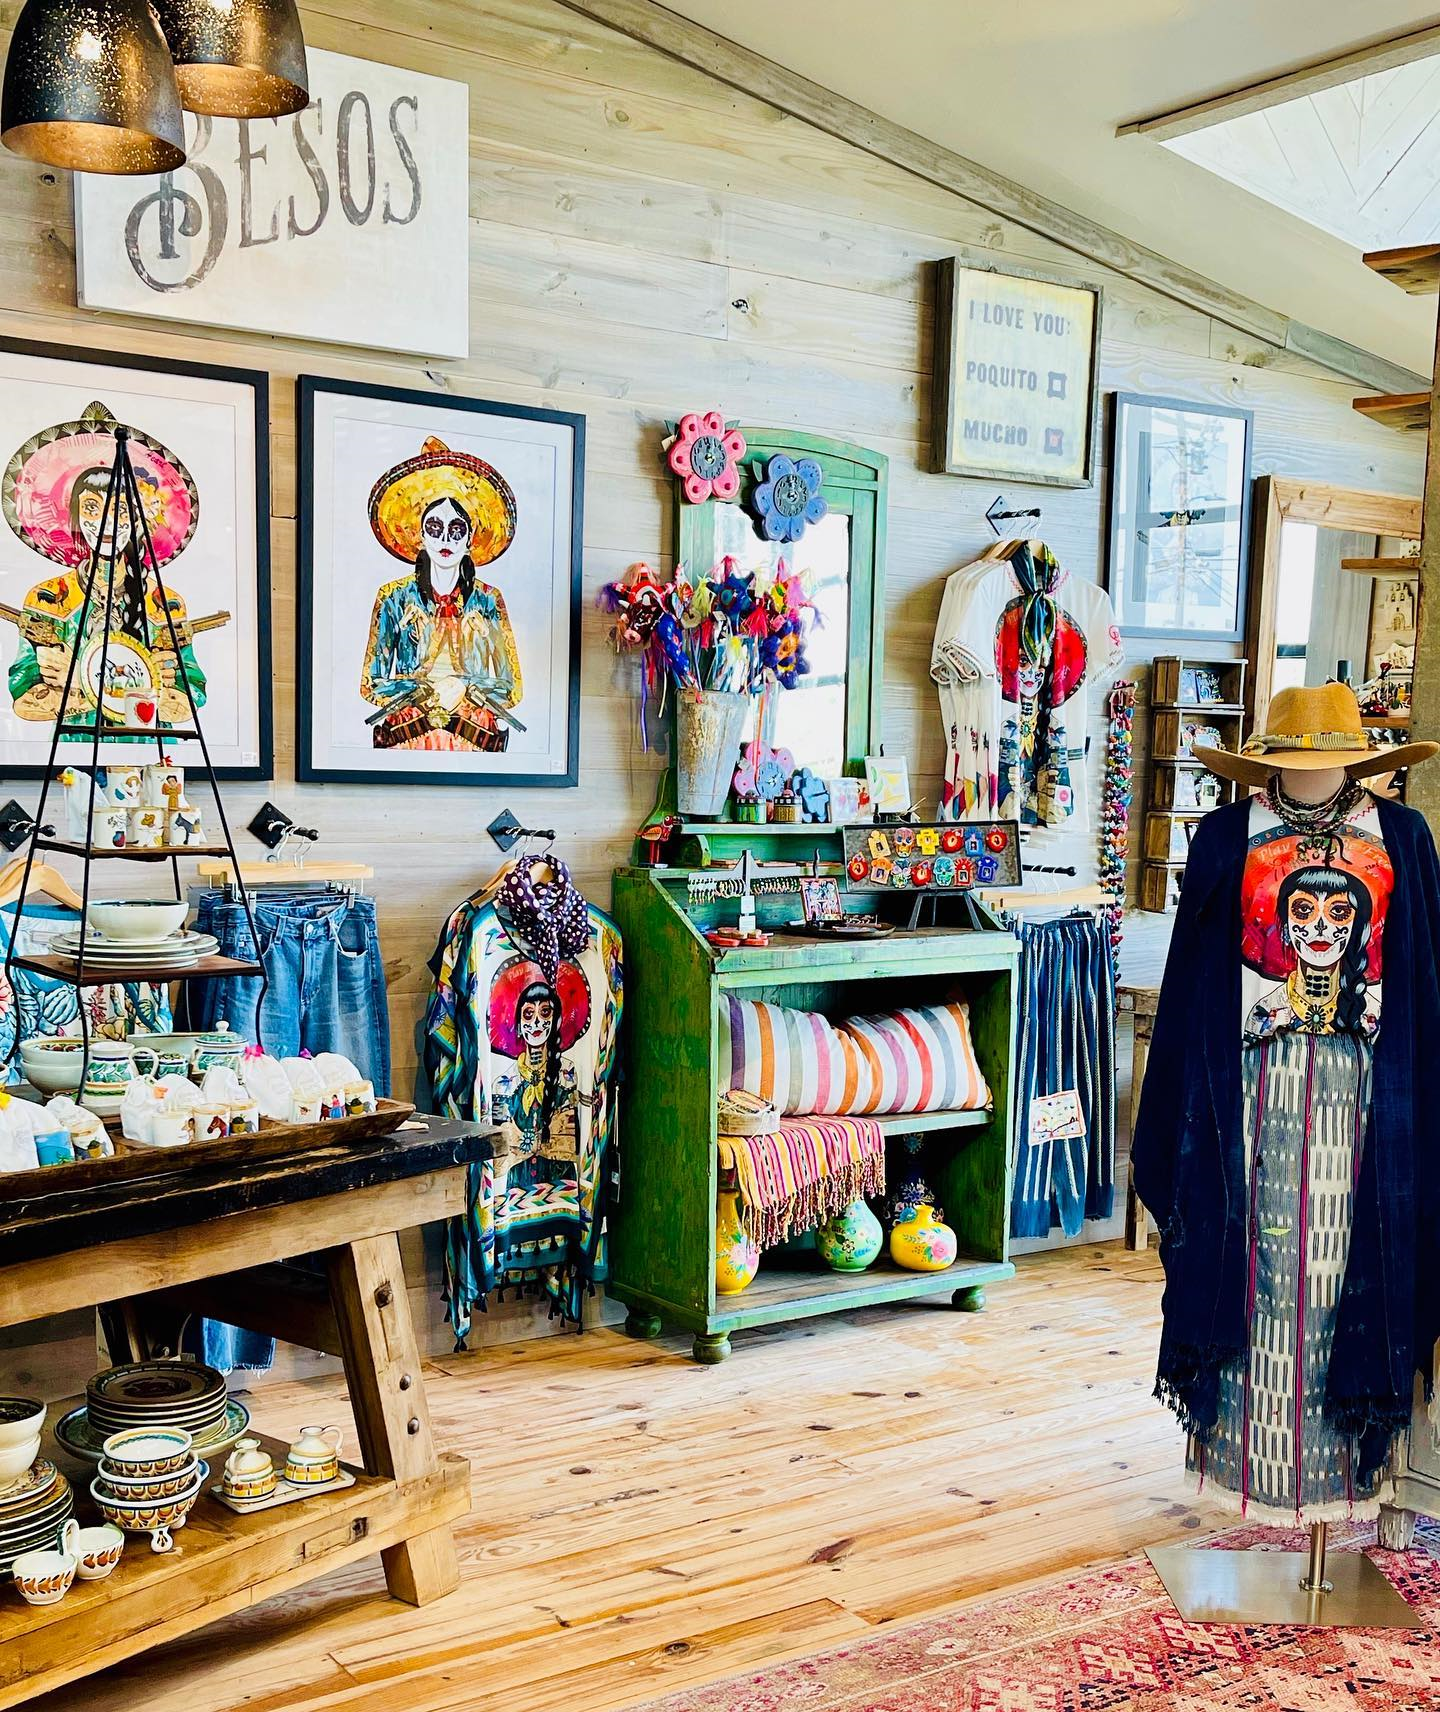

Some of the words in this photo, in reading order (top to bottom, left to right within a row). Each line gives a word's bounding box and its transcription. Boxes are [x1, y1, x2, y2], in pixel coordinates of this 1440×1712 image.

[124, 91, 423, 294] BESOS
[969, 299, 976, 320] I
[983, 302, 1025, 330] LOVE
[966, 360, 1038, 392] POQUITO
[963, 418, 1029, 447] MUCHO
